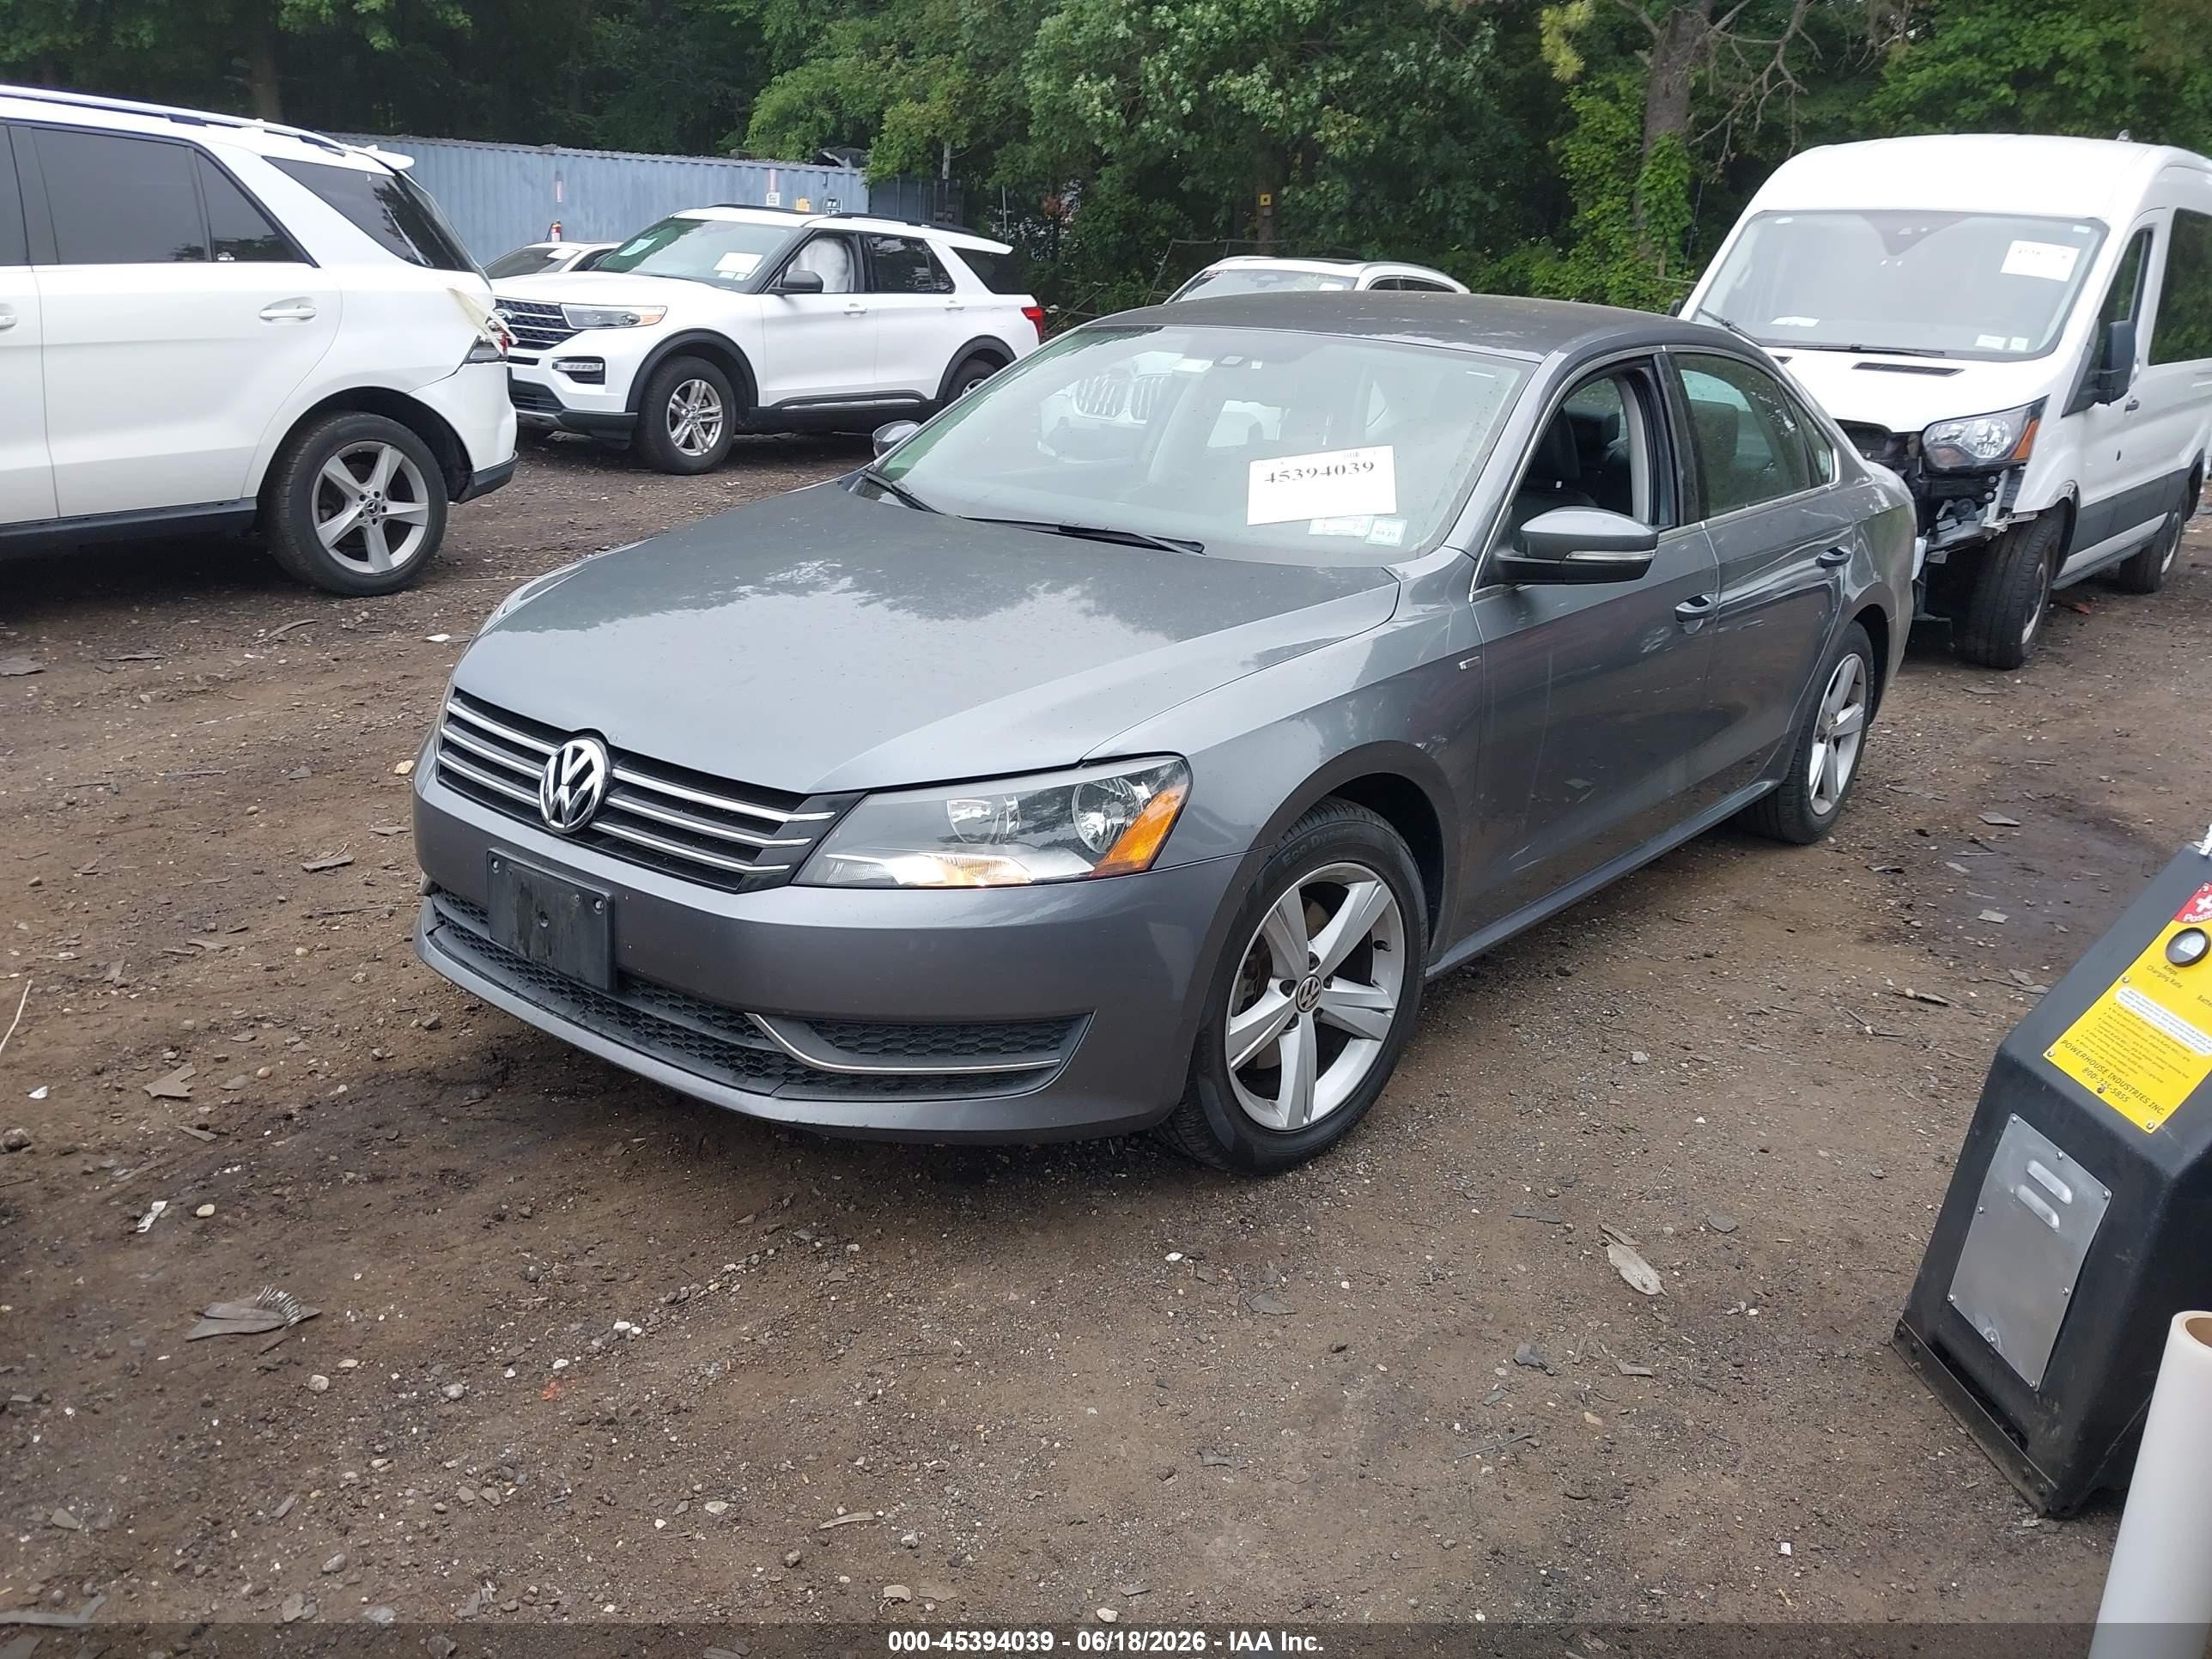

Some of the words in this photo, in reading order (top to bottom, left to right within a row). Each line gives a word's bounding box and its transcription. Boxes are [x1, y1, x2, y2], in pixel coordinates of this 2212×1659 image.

[1264, 460, 1375, 483] 45394039
[1281, 843, 1308, 867] Eco
[2061, 1039, 2109, 1075] POWERHOUSE
[2107, 1072, 2151, 1104] INDUSTRIES
[2148, 1102, 2165, 1115] INC.
